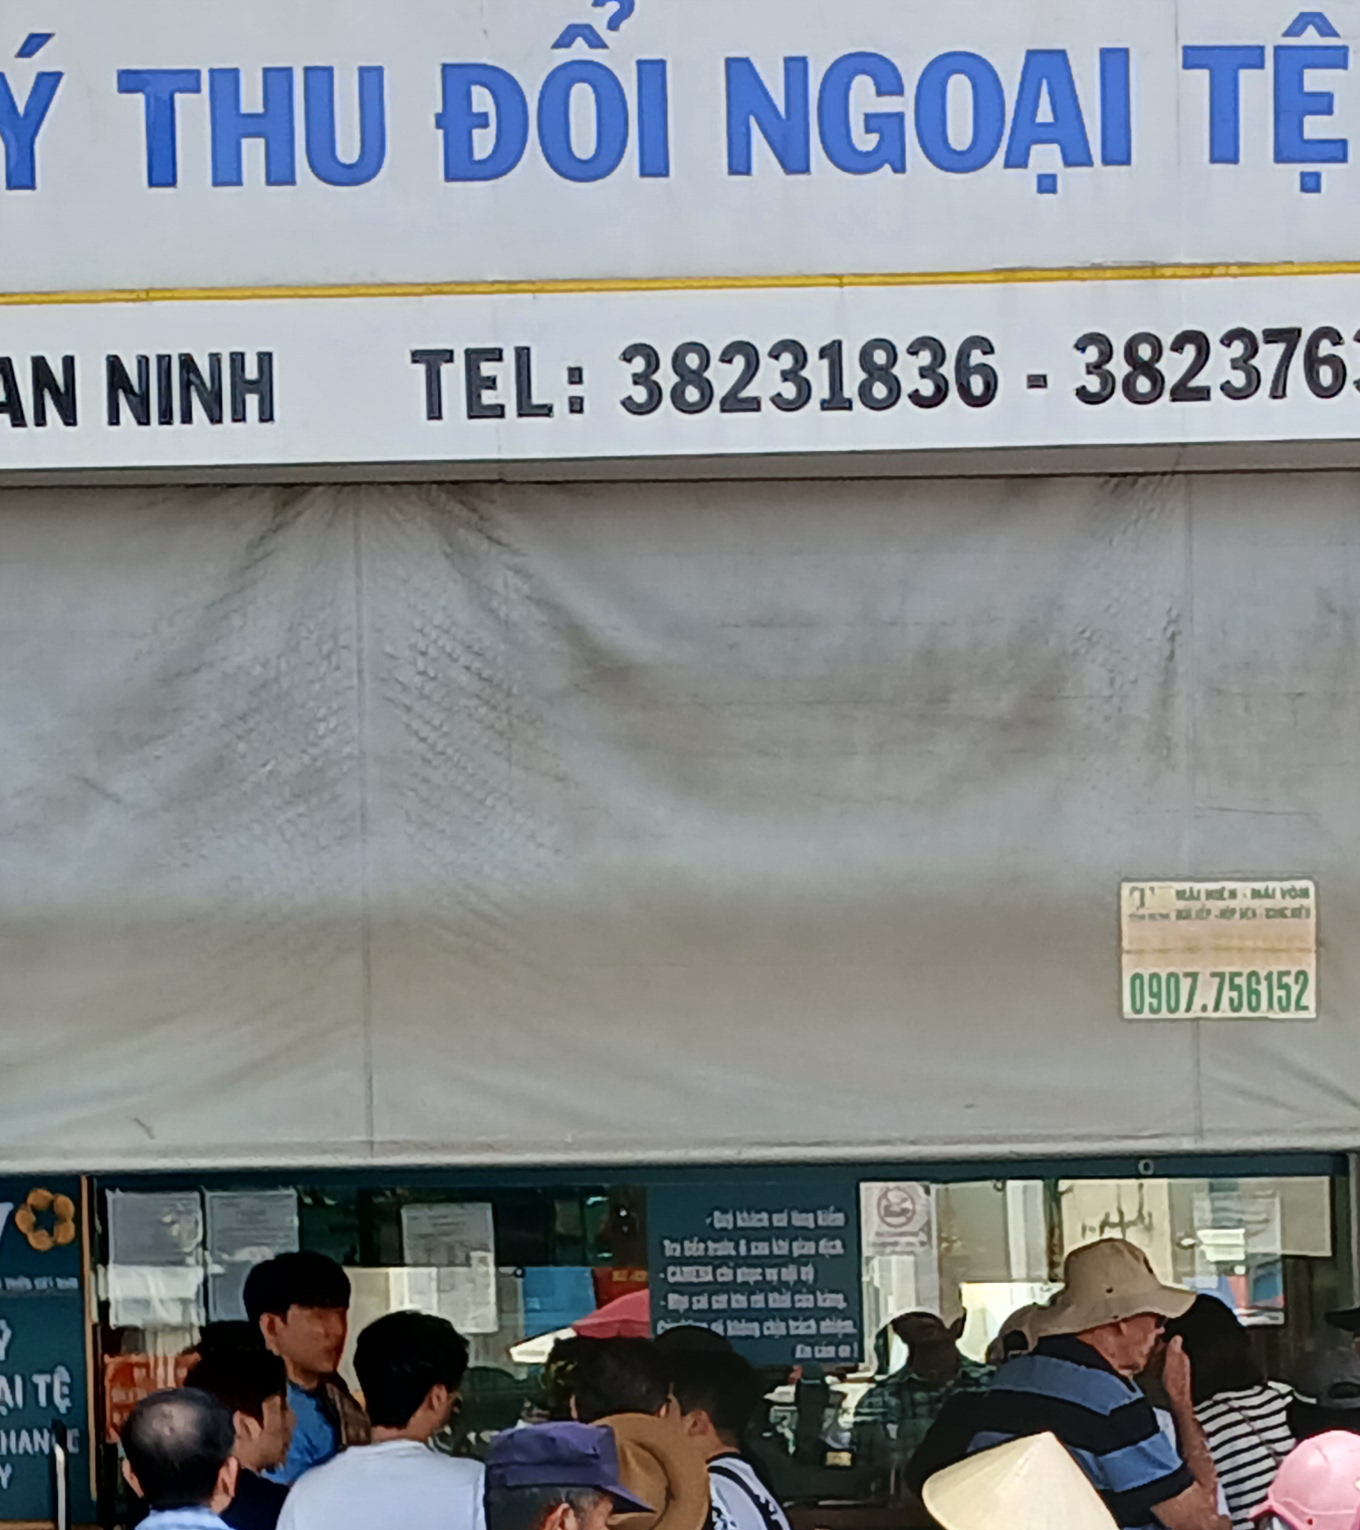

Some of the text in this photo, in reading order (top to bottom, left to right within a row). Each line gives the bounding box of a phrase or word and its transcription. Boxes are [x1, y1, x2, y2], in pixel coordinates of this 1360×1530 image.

[117, 65, 385, 187] THU
[435, 0, 670, 182] ĐỔI
[725, 47, 1131, 193] NGOẠI
[1182, 12, 1348, 192] TỆ
[107, 350, 274, 426] NINH
[411, 347, 585, 420] TEL:
[620, 335, 998, 416] 38231836
[1026, 374, 1048, 389] -
[1129, 969, 1310, 1015] 0907.756152
[32, 1366, 71, 1413] TỆ
